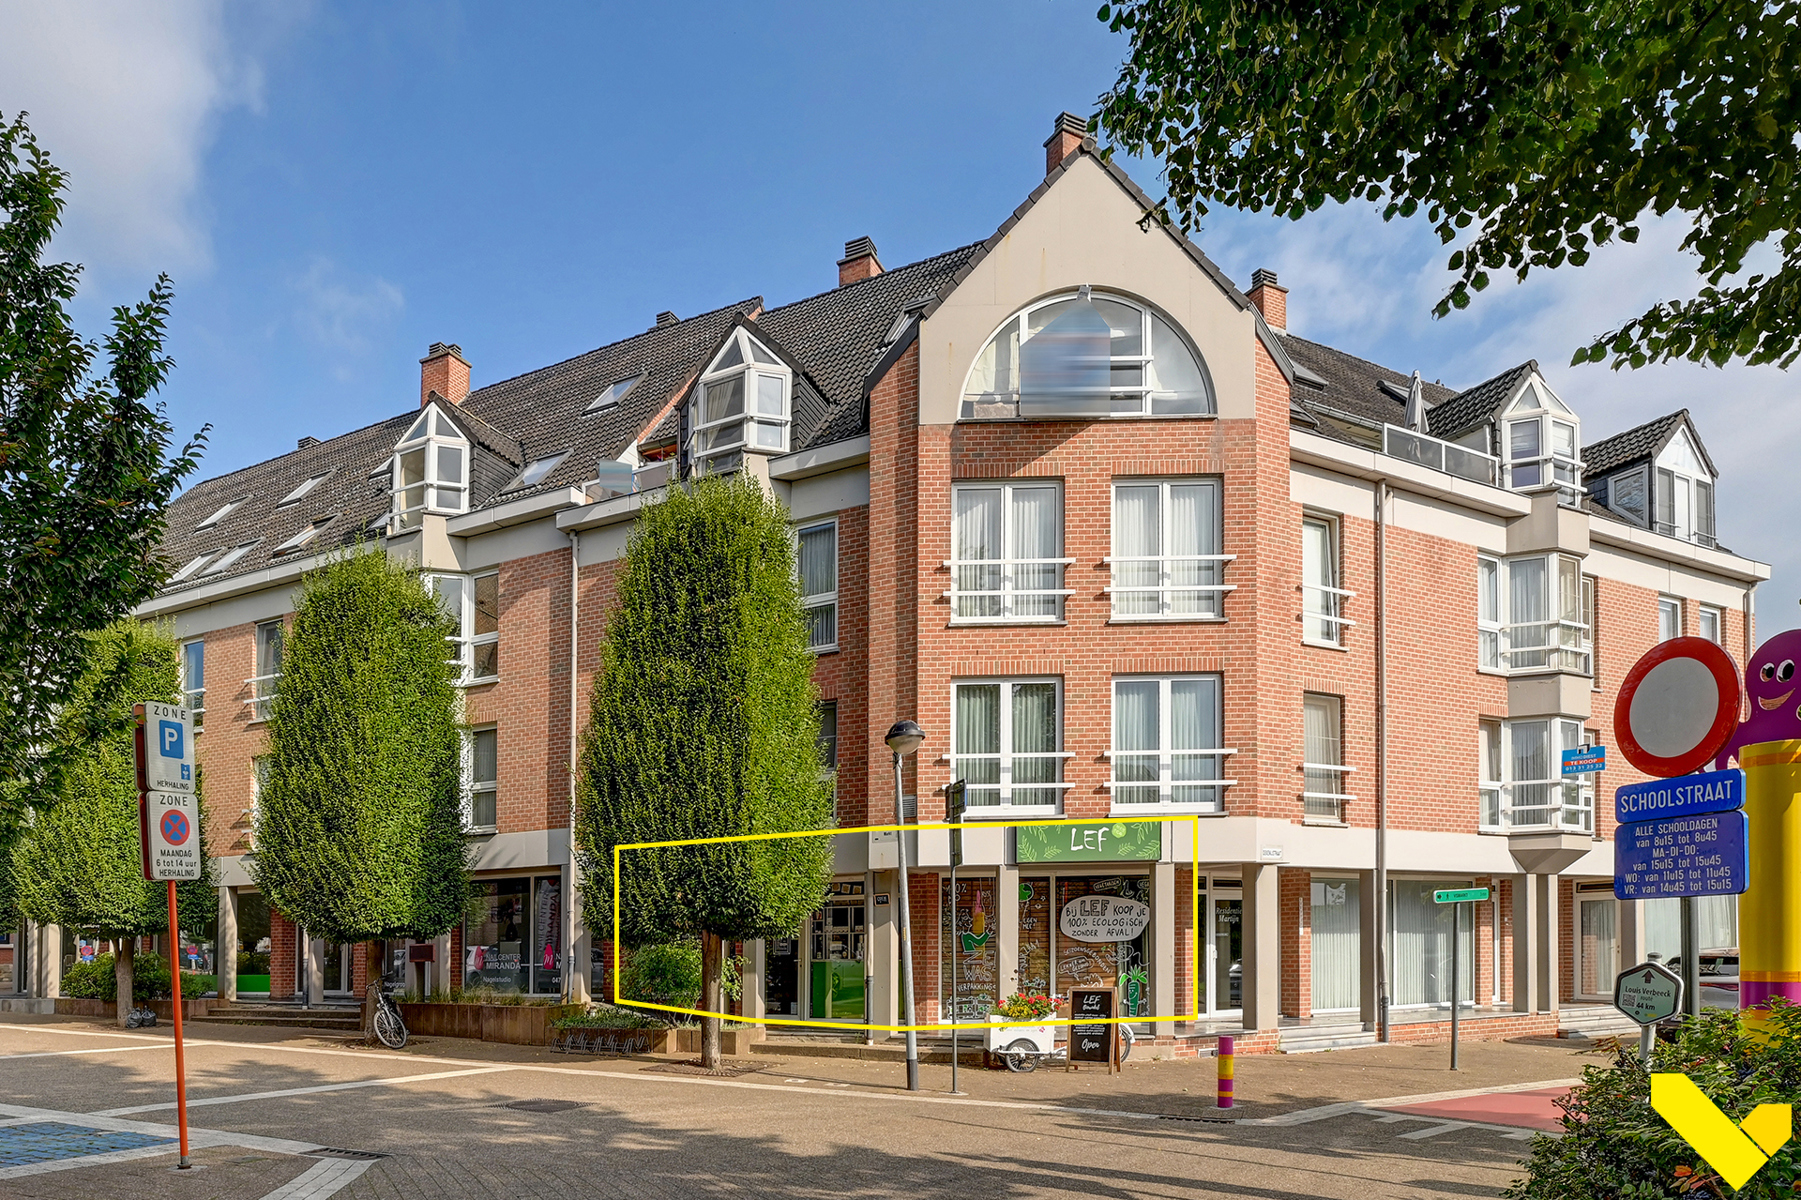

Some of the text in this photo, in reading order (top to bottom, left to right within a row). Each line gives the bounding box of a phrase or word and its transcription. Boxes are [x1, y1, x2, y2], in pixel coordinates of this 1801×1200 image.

[154, 705, 186, 720] ZONE
[164, 727, 178, 751] P
[157, 780, 189, 790] HERHALING
[160, 795, 188, 806] ZONE
[1620, 780, 1733, 813] SCHOOLSTRAAT
[1635, 818, 1718, 837] ALLE SCHOOLDAGEN
[1070, 826, 1109, 852] LEF
[1636, 830, 1718, 848] van 8u15 tot 8u45
[160, 849, 192, 858] MAANDAG
[1652, 845, 1700, 858] MA-DI-DO:
[156, 859, 161, 867] 6
[176, 859, 183, 867] 14
[1633, 854, 1721, 871] van 15u15 tot 15u45
[159, 869, 195, 877] HERHALING
[1625, 866, 1731, 883] WO: van 11u15 tot 11u45
[1624, 879, 1732, 895] VR: van 14u45 tot 15u15
[1080, 899, 1110, 917] LEF
[1113, 905, 1134, 916] KOOP
[1066, 918, 1088, 928] 100%
[1072, 928, 1134, 937] ZONDER AFVAL!
[1625, 986, 1671, 997] Louis Verbeeck
[1083, 995, 1101, 1004] LEF
[1081, 1038, 1100, 1052] Open
